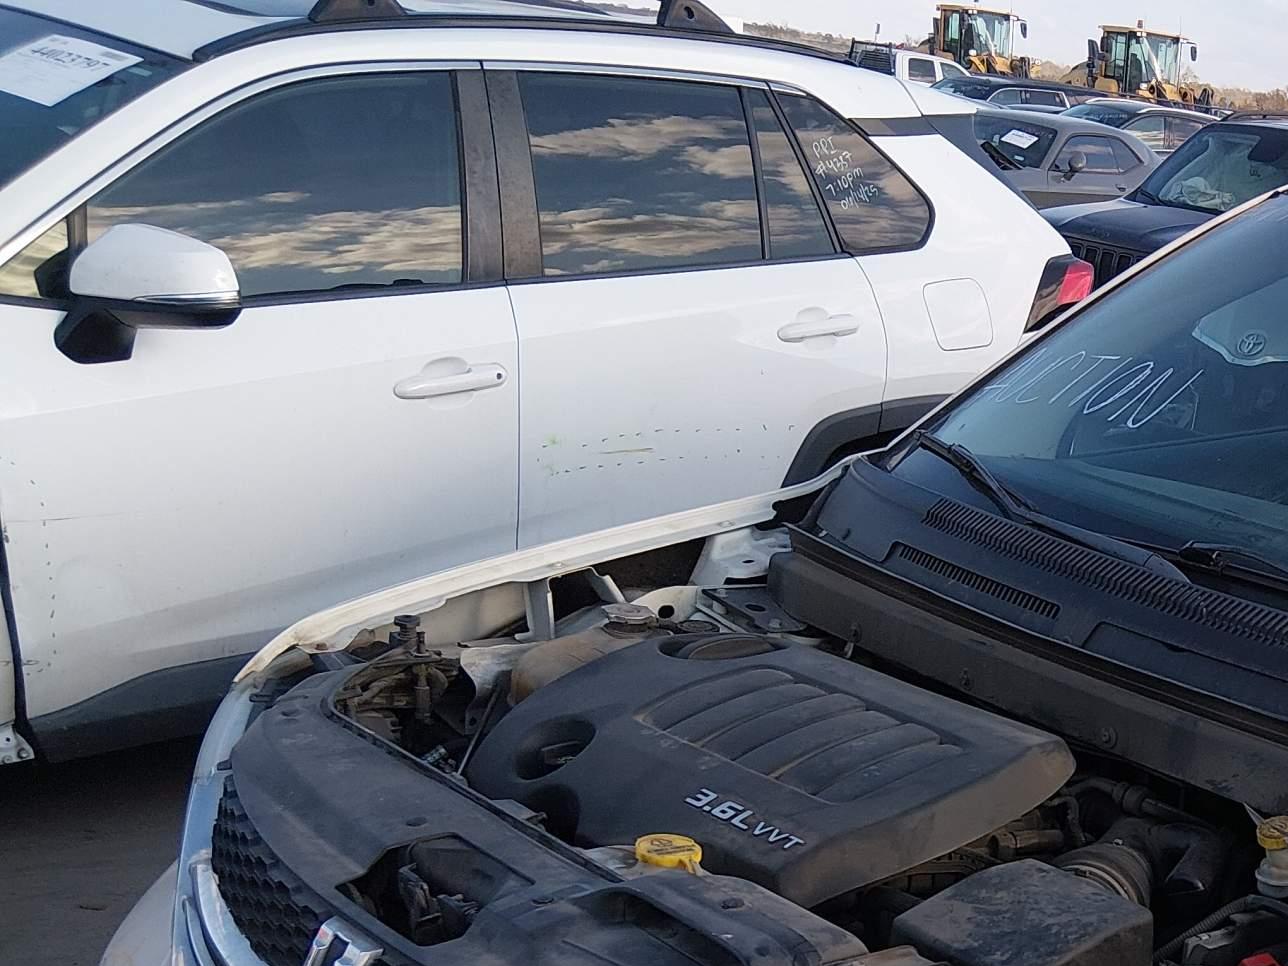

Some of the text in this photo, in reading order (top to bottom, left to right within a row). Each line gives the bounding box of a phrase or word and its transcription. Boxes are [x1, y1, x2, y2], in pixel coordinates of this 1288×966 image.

[812, 136, 838, 159] PPI
[685, 788, 805, 849] 3.6L VVT
